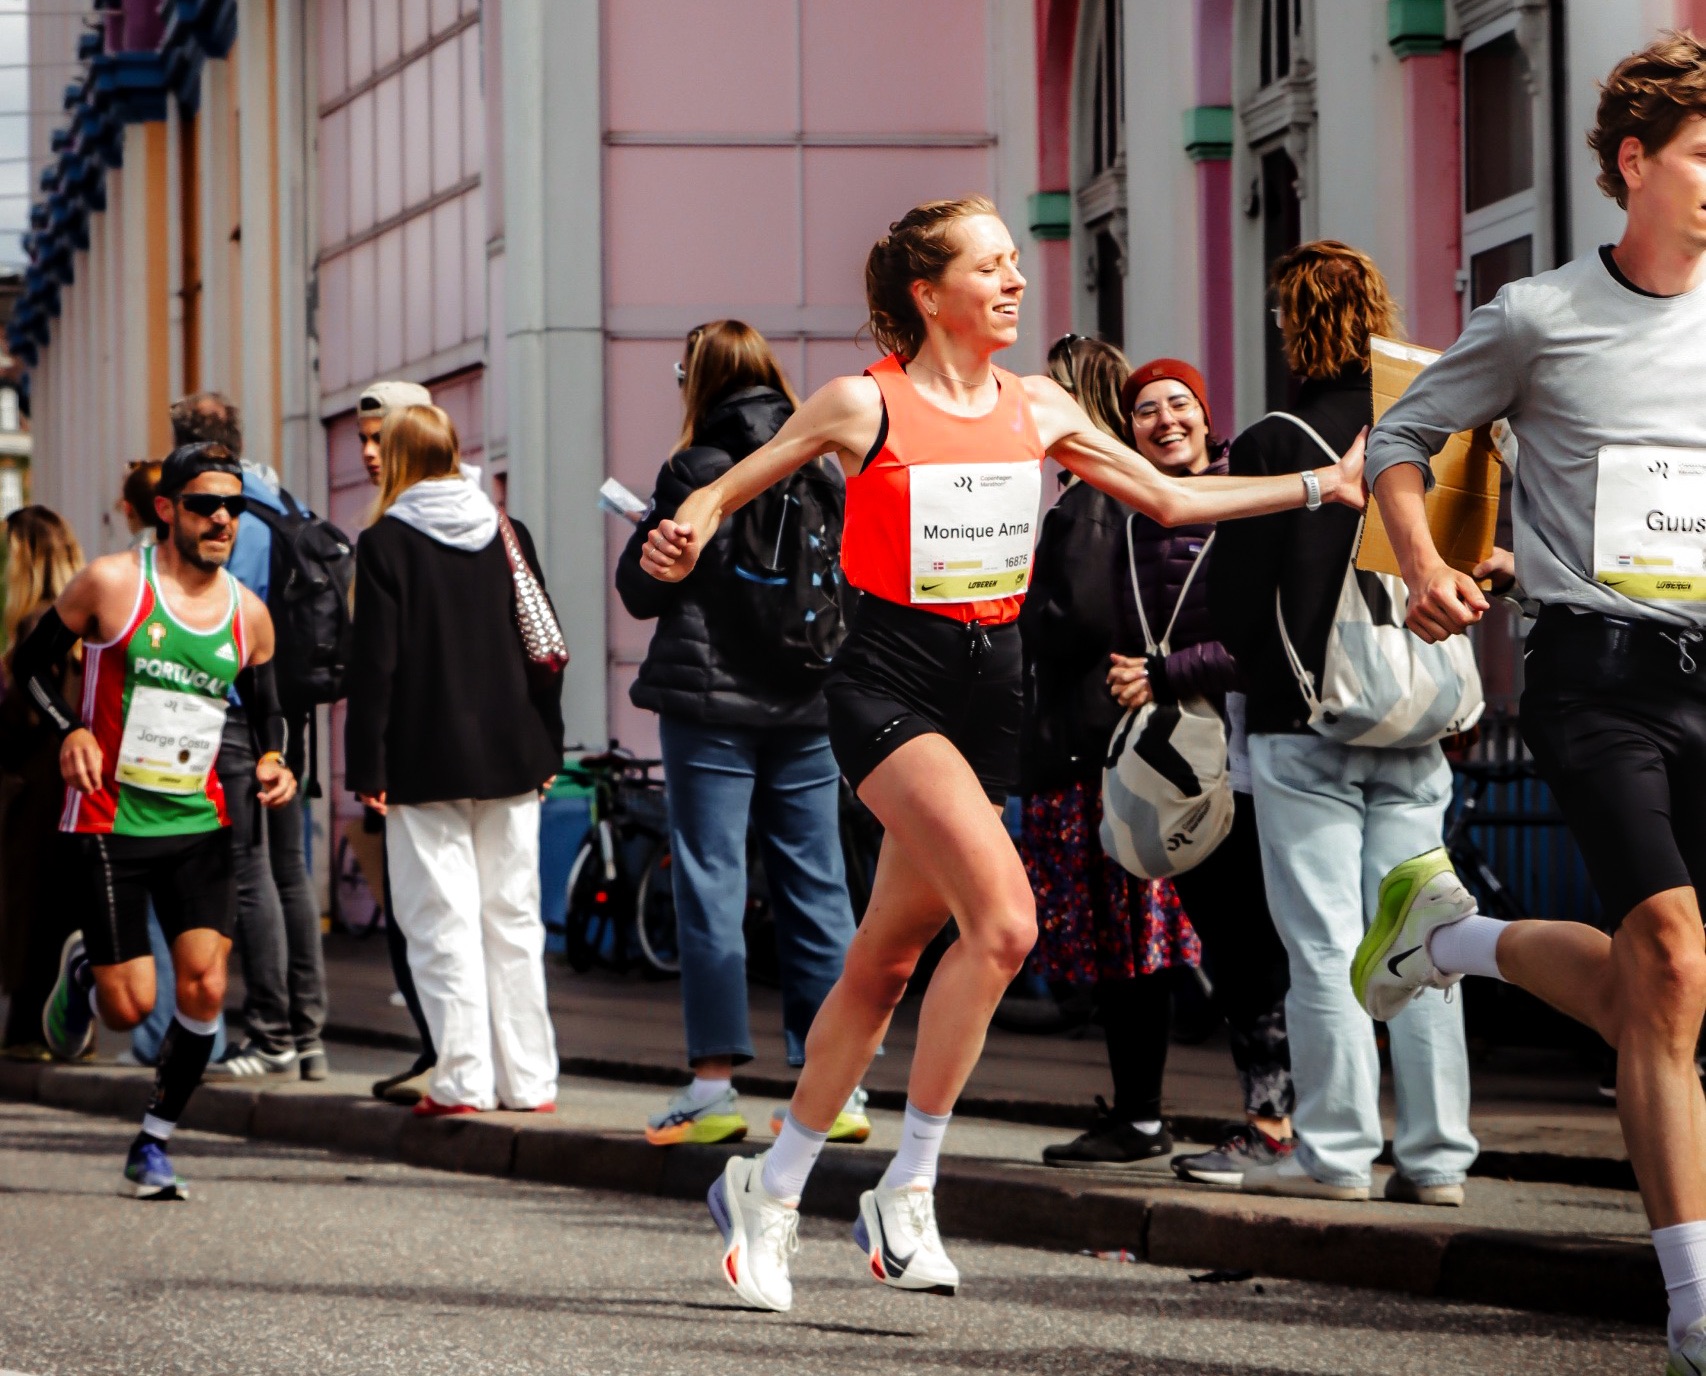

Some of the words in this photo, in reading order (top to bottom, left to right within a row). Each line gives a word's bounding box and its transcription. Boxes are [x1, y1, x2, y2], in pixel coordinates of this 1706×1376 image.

[924, 524, 994, 541] Monique
[998, 522, 1029, 537] Anna
[1005, 554, 1028, 568] 16875
[134, 657, 226, 695] PORTUGAL
[137, 729, 174, 747] Jorge
[178, 736, 210, 750] Costa
